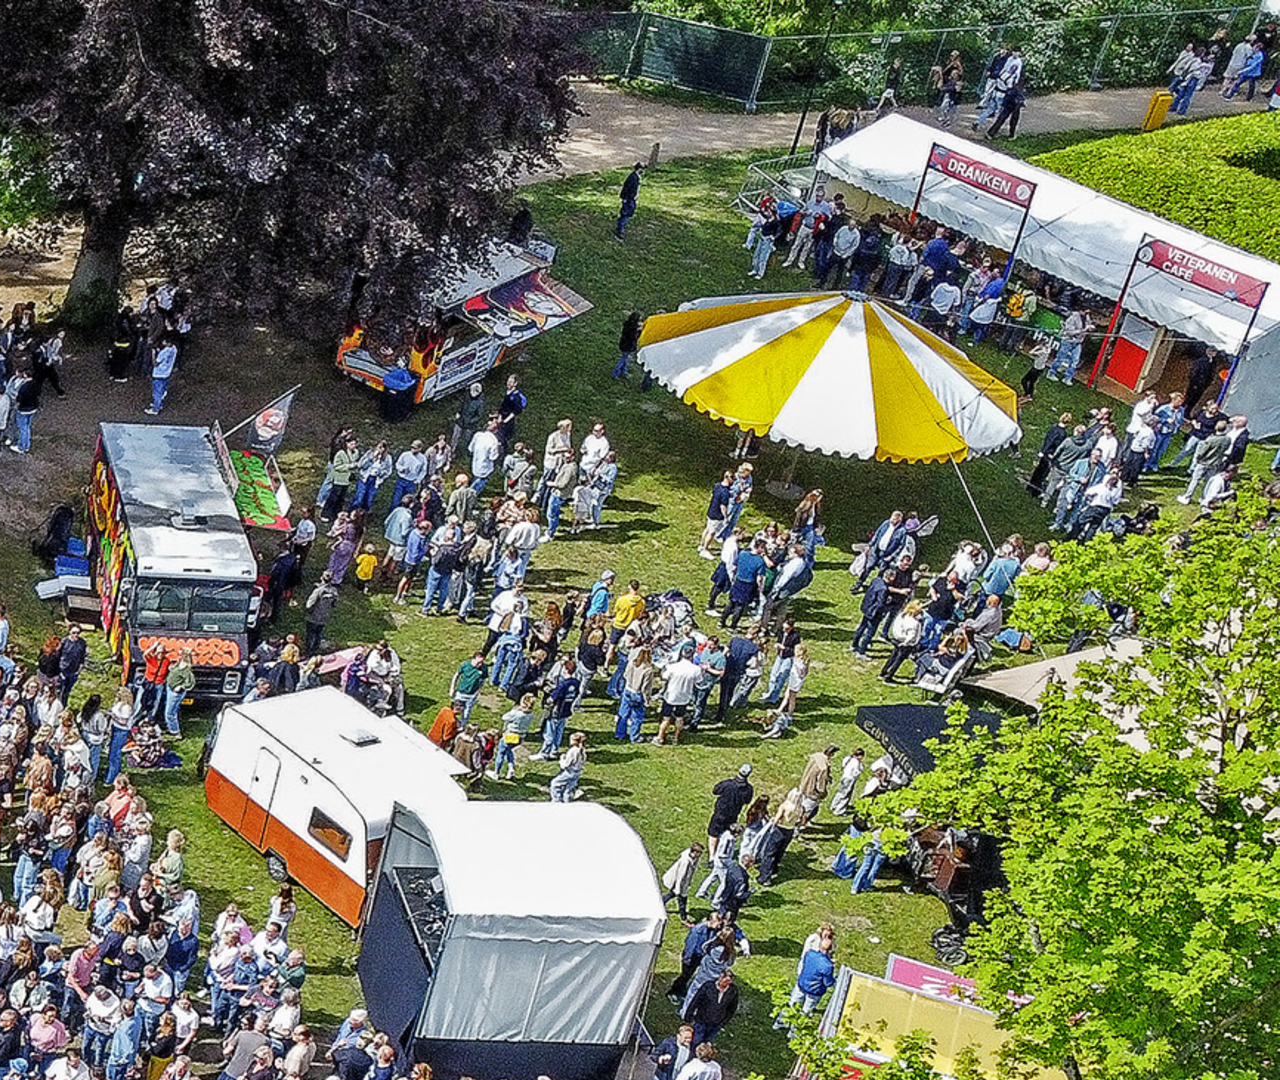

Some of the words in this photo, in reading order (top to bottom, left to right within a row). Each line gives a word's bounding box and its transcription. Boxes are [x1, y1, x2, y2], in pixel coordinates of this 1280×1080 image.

[947, 158, 1012, 195] DRANKEN
[1162, 261, 1194, 281] CAFÉ
[1168, 247, 1239, 285] VETERANEN
